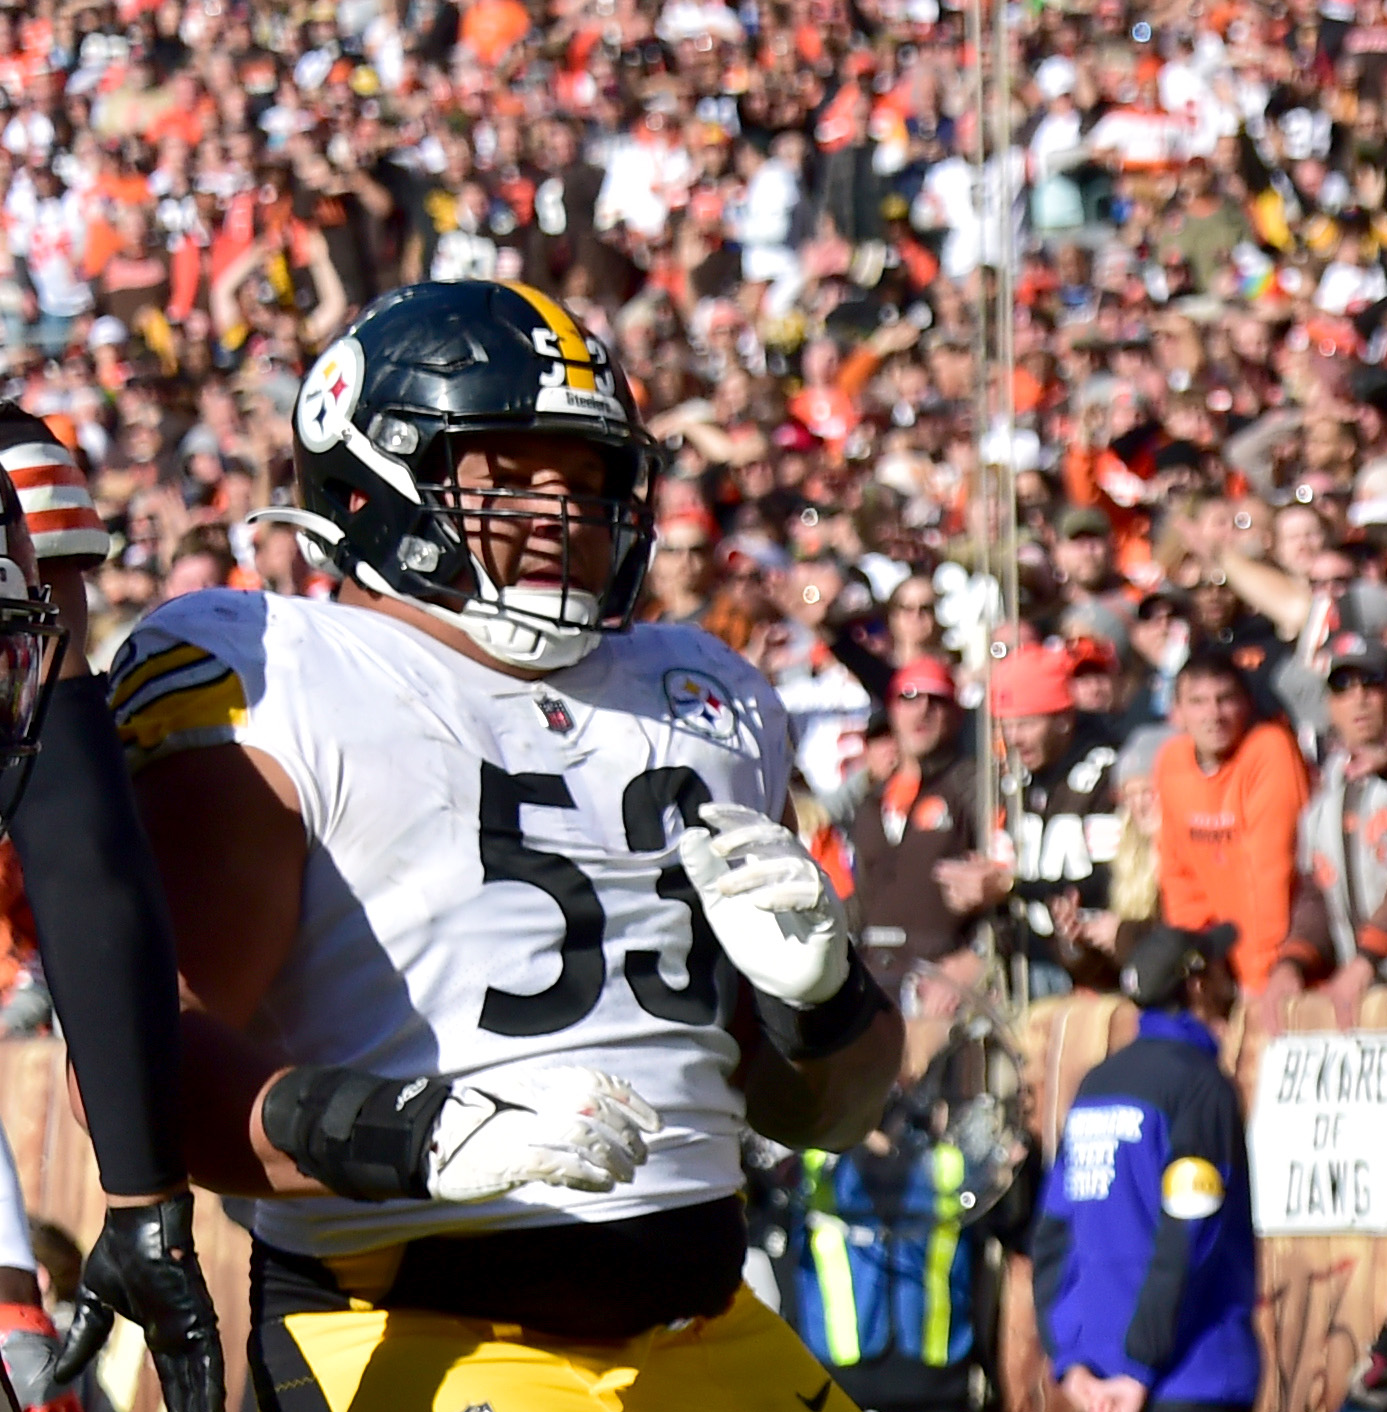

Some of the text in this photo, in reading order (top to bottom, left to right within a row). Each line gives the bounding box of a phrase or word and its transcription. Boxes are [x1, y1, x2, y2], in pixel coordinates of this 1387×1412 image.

[478, 759, 725, 1036] 53
[1313, 1112, 1346, 1150] OF
[1285, 1159, 1371, 1217] DAWG
